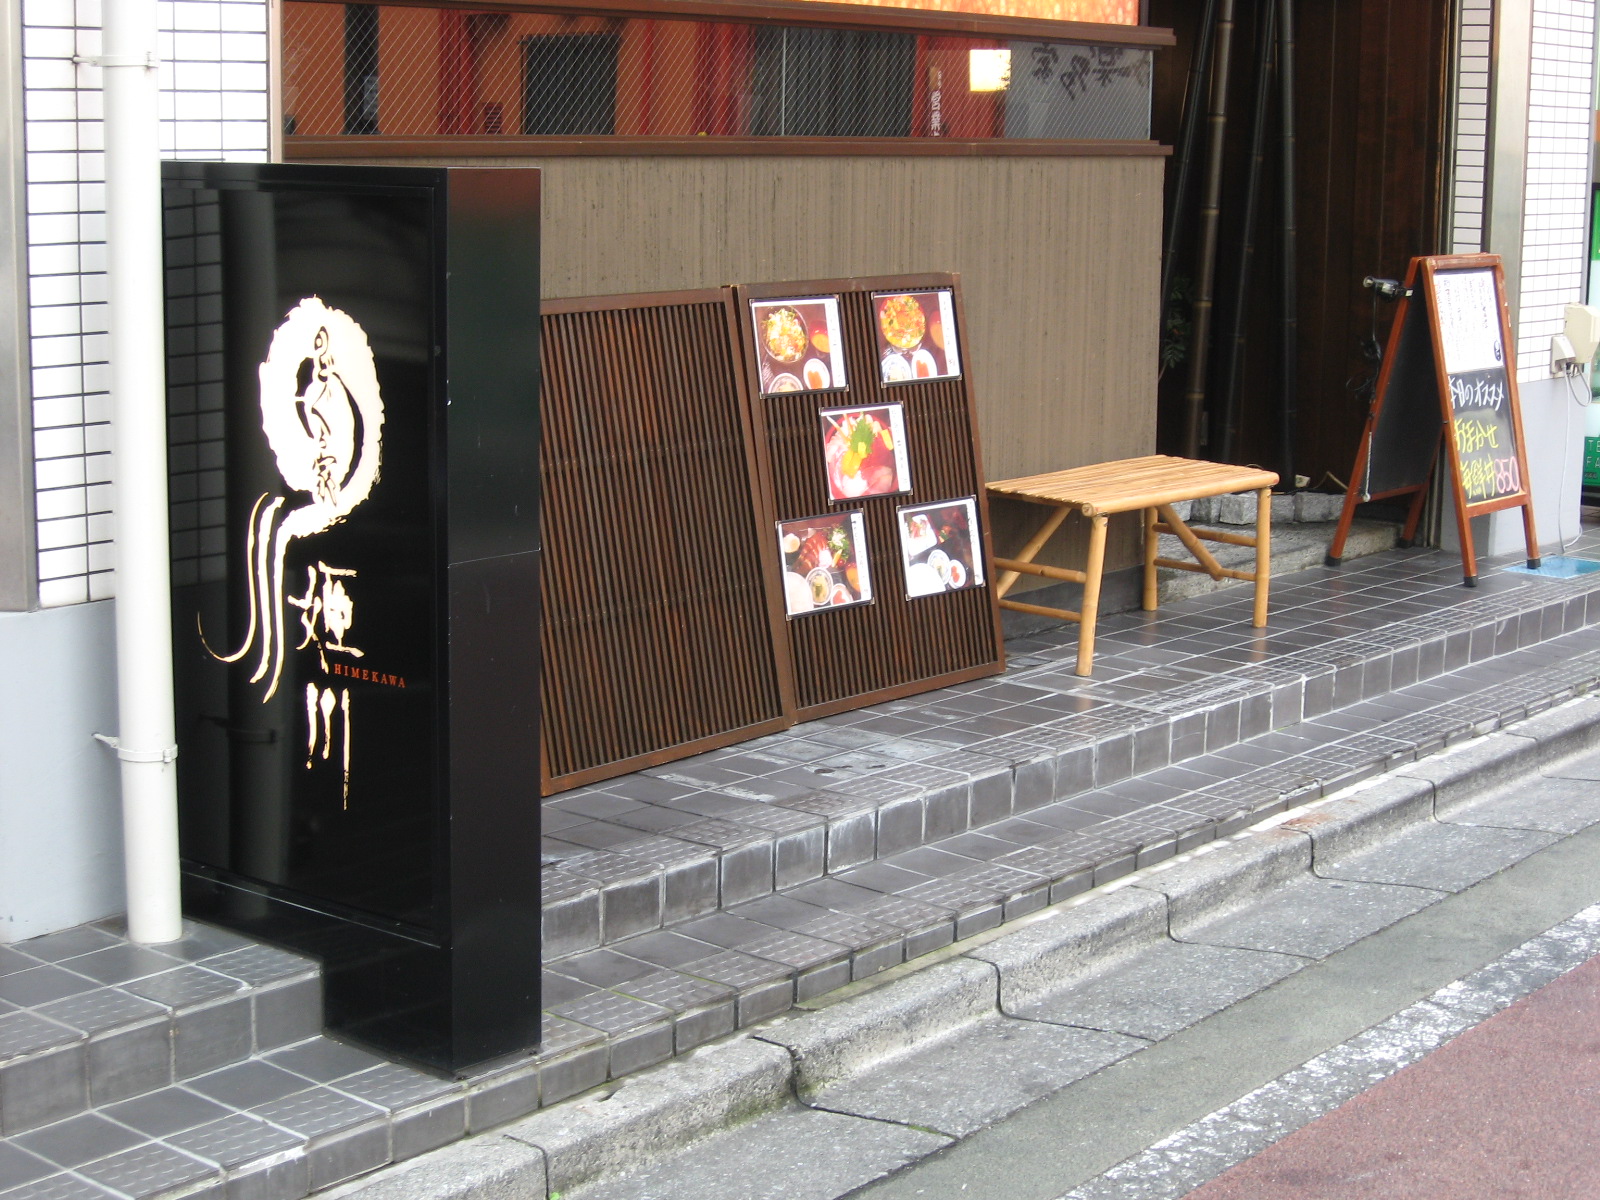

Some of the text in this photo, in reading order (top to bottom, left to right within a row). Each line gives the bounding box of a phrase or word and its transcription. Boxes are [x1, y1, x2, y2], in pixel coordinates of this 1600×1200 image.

[1448, 376, 1504, 411] 本日のオススメ
[1494, 456, 1520, 493] 850
[334, 663, 406, 688] HIMEKAWA
